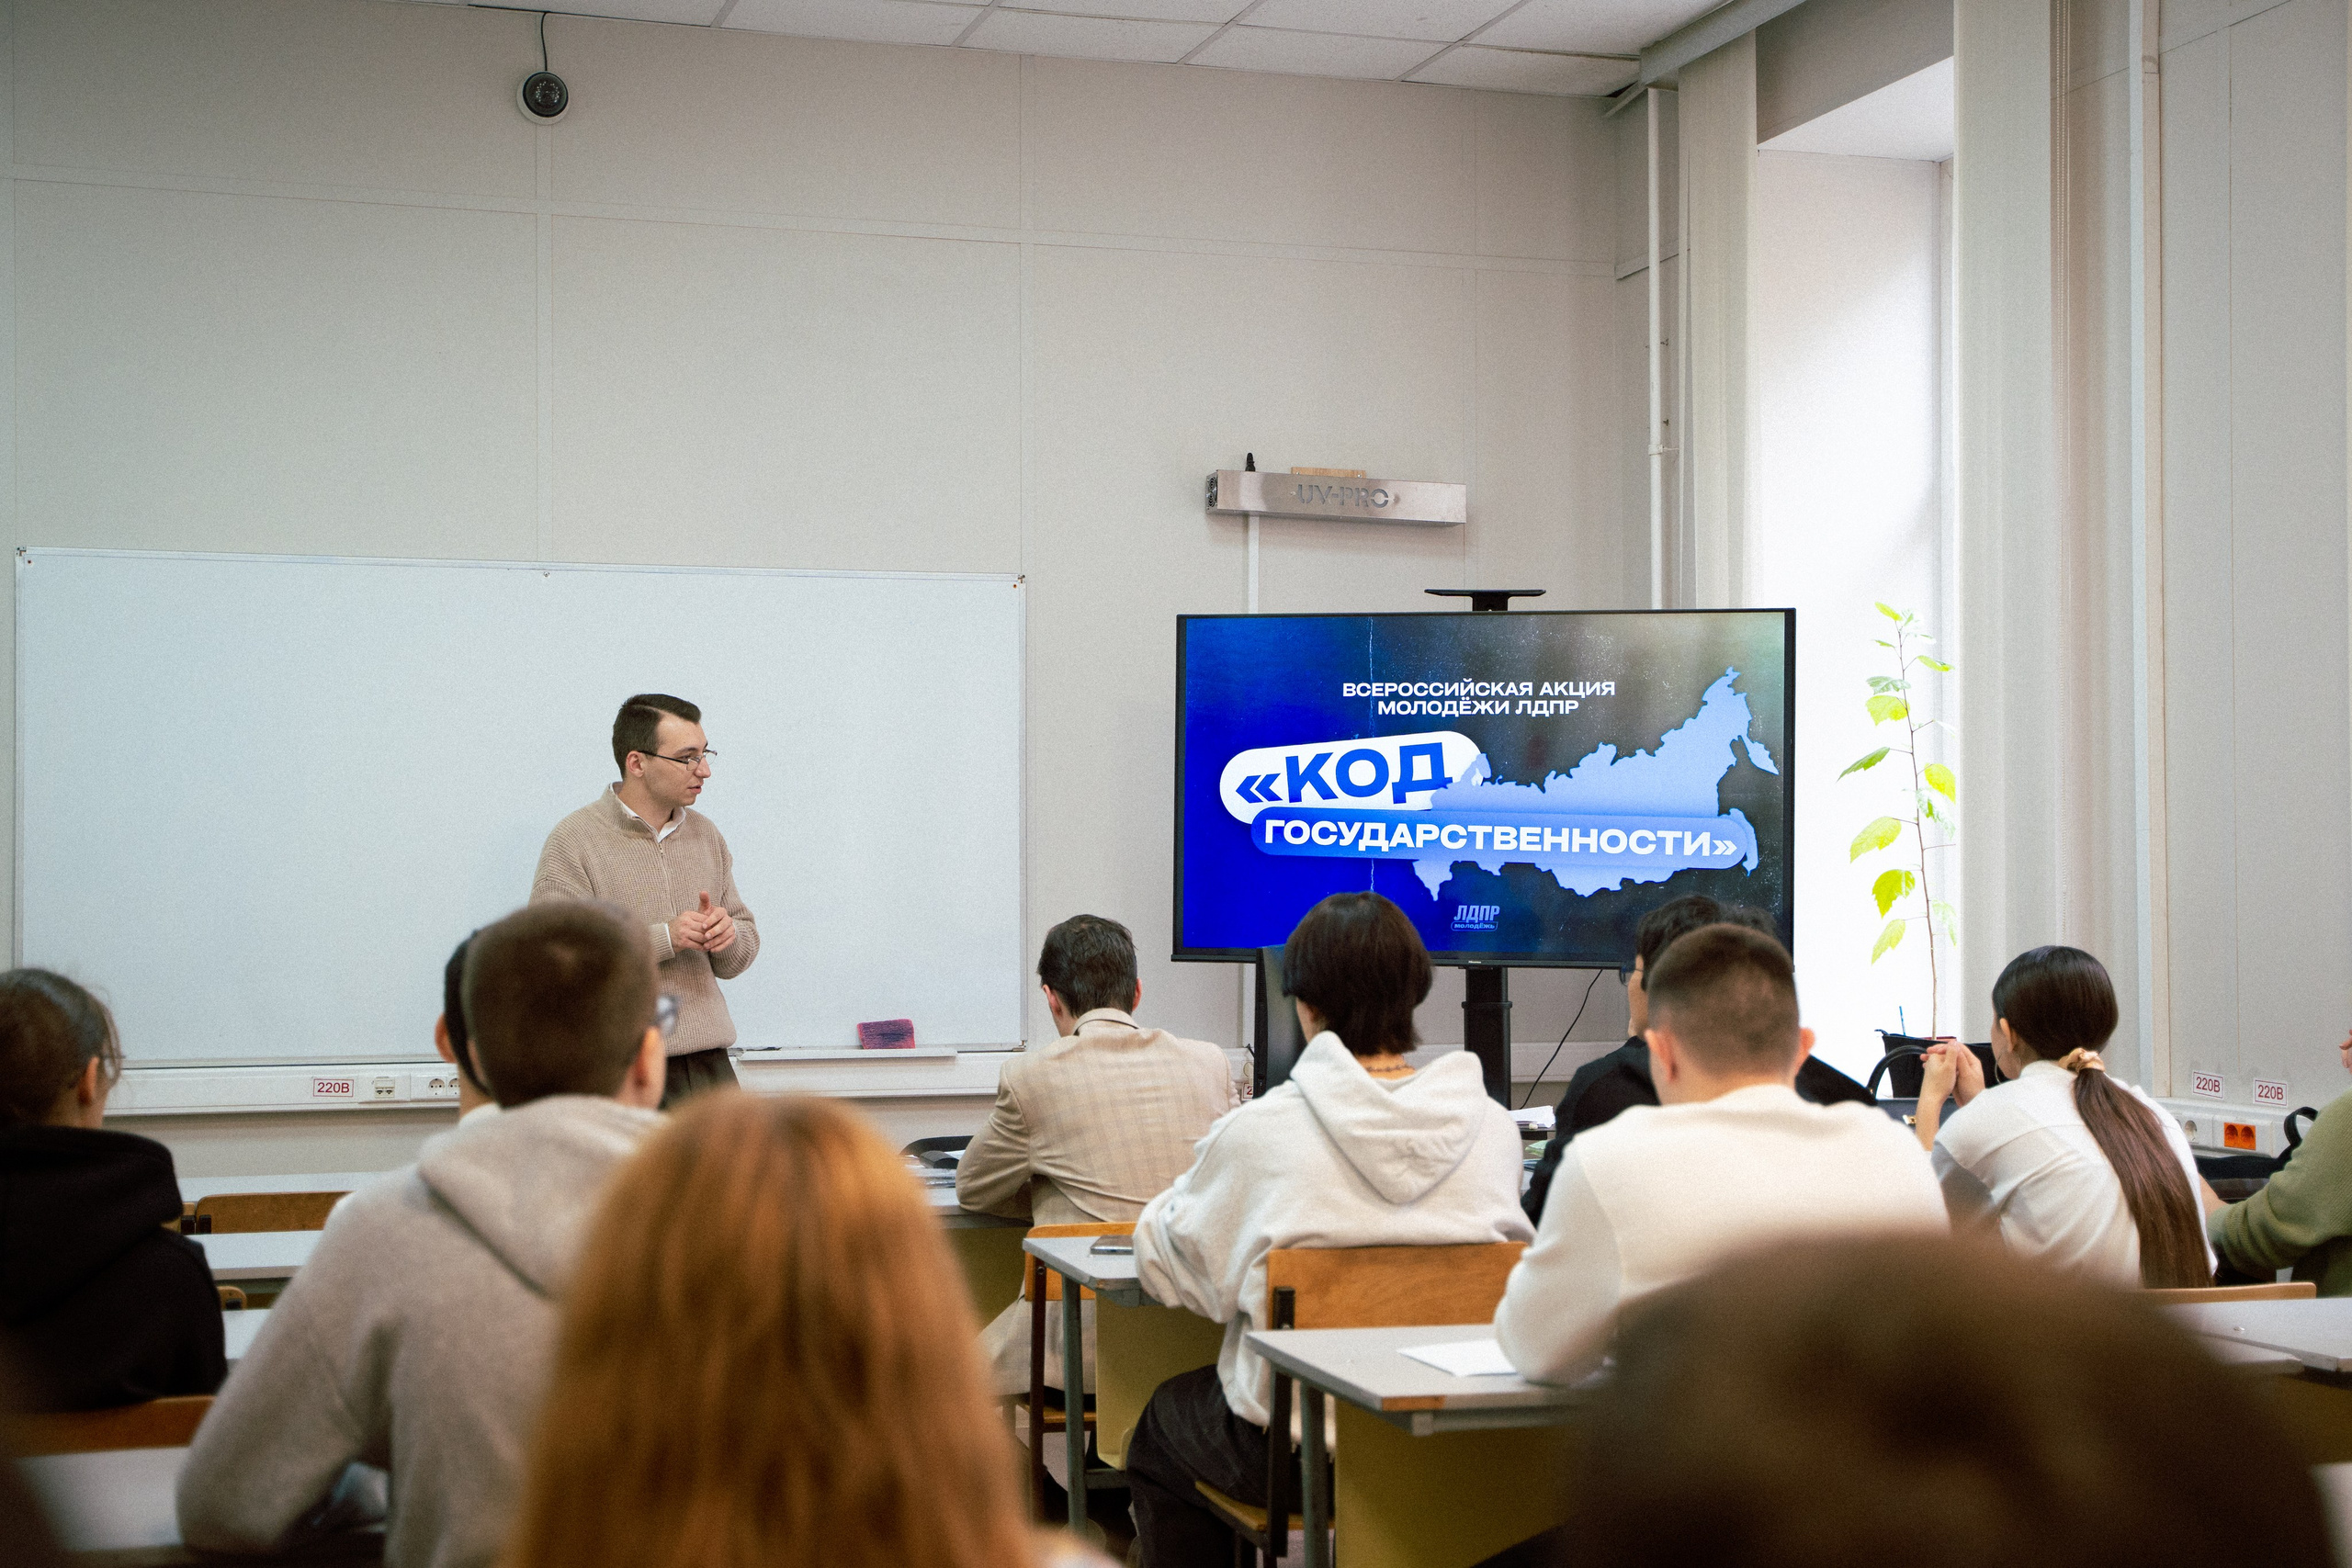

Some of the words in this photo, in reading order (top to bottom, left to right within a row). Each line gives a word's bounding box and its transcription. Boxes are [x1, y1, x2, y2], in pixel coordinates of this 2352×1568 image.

[1297, 484, 1388, 508] UV-PRO
[1342, 678, 1533, 697] ВСЕРОССИЙСКАЯ
[1539, 681, 1616, 699] АКЦИЯ
[1378, 696, 1510, 717] МОЛОДЁЖИ
[1515, 700, 1579, 716] ЛДПР
[1236, 742, 1453, 804] «КОД
[1264, 818, 1738, 857] ГОСУДАРСТВЕННОСТИ»
[1453, 905, 1500, 923] ЛДПР
